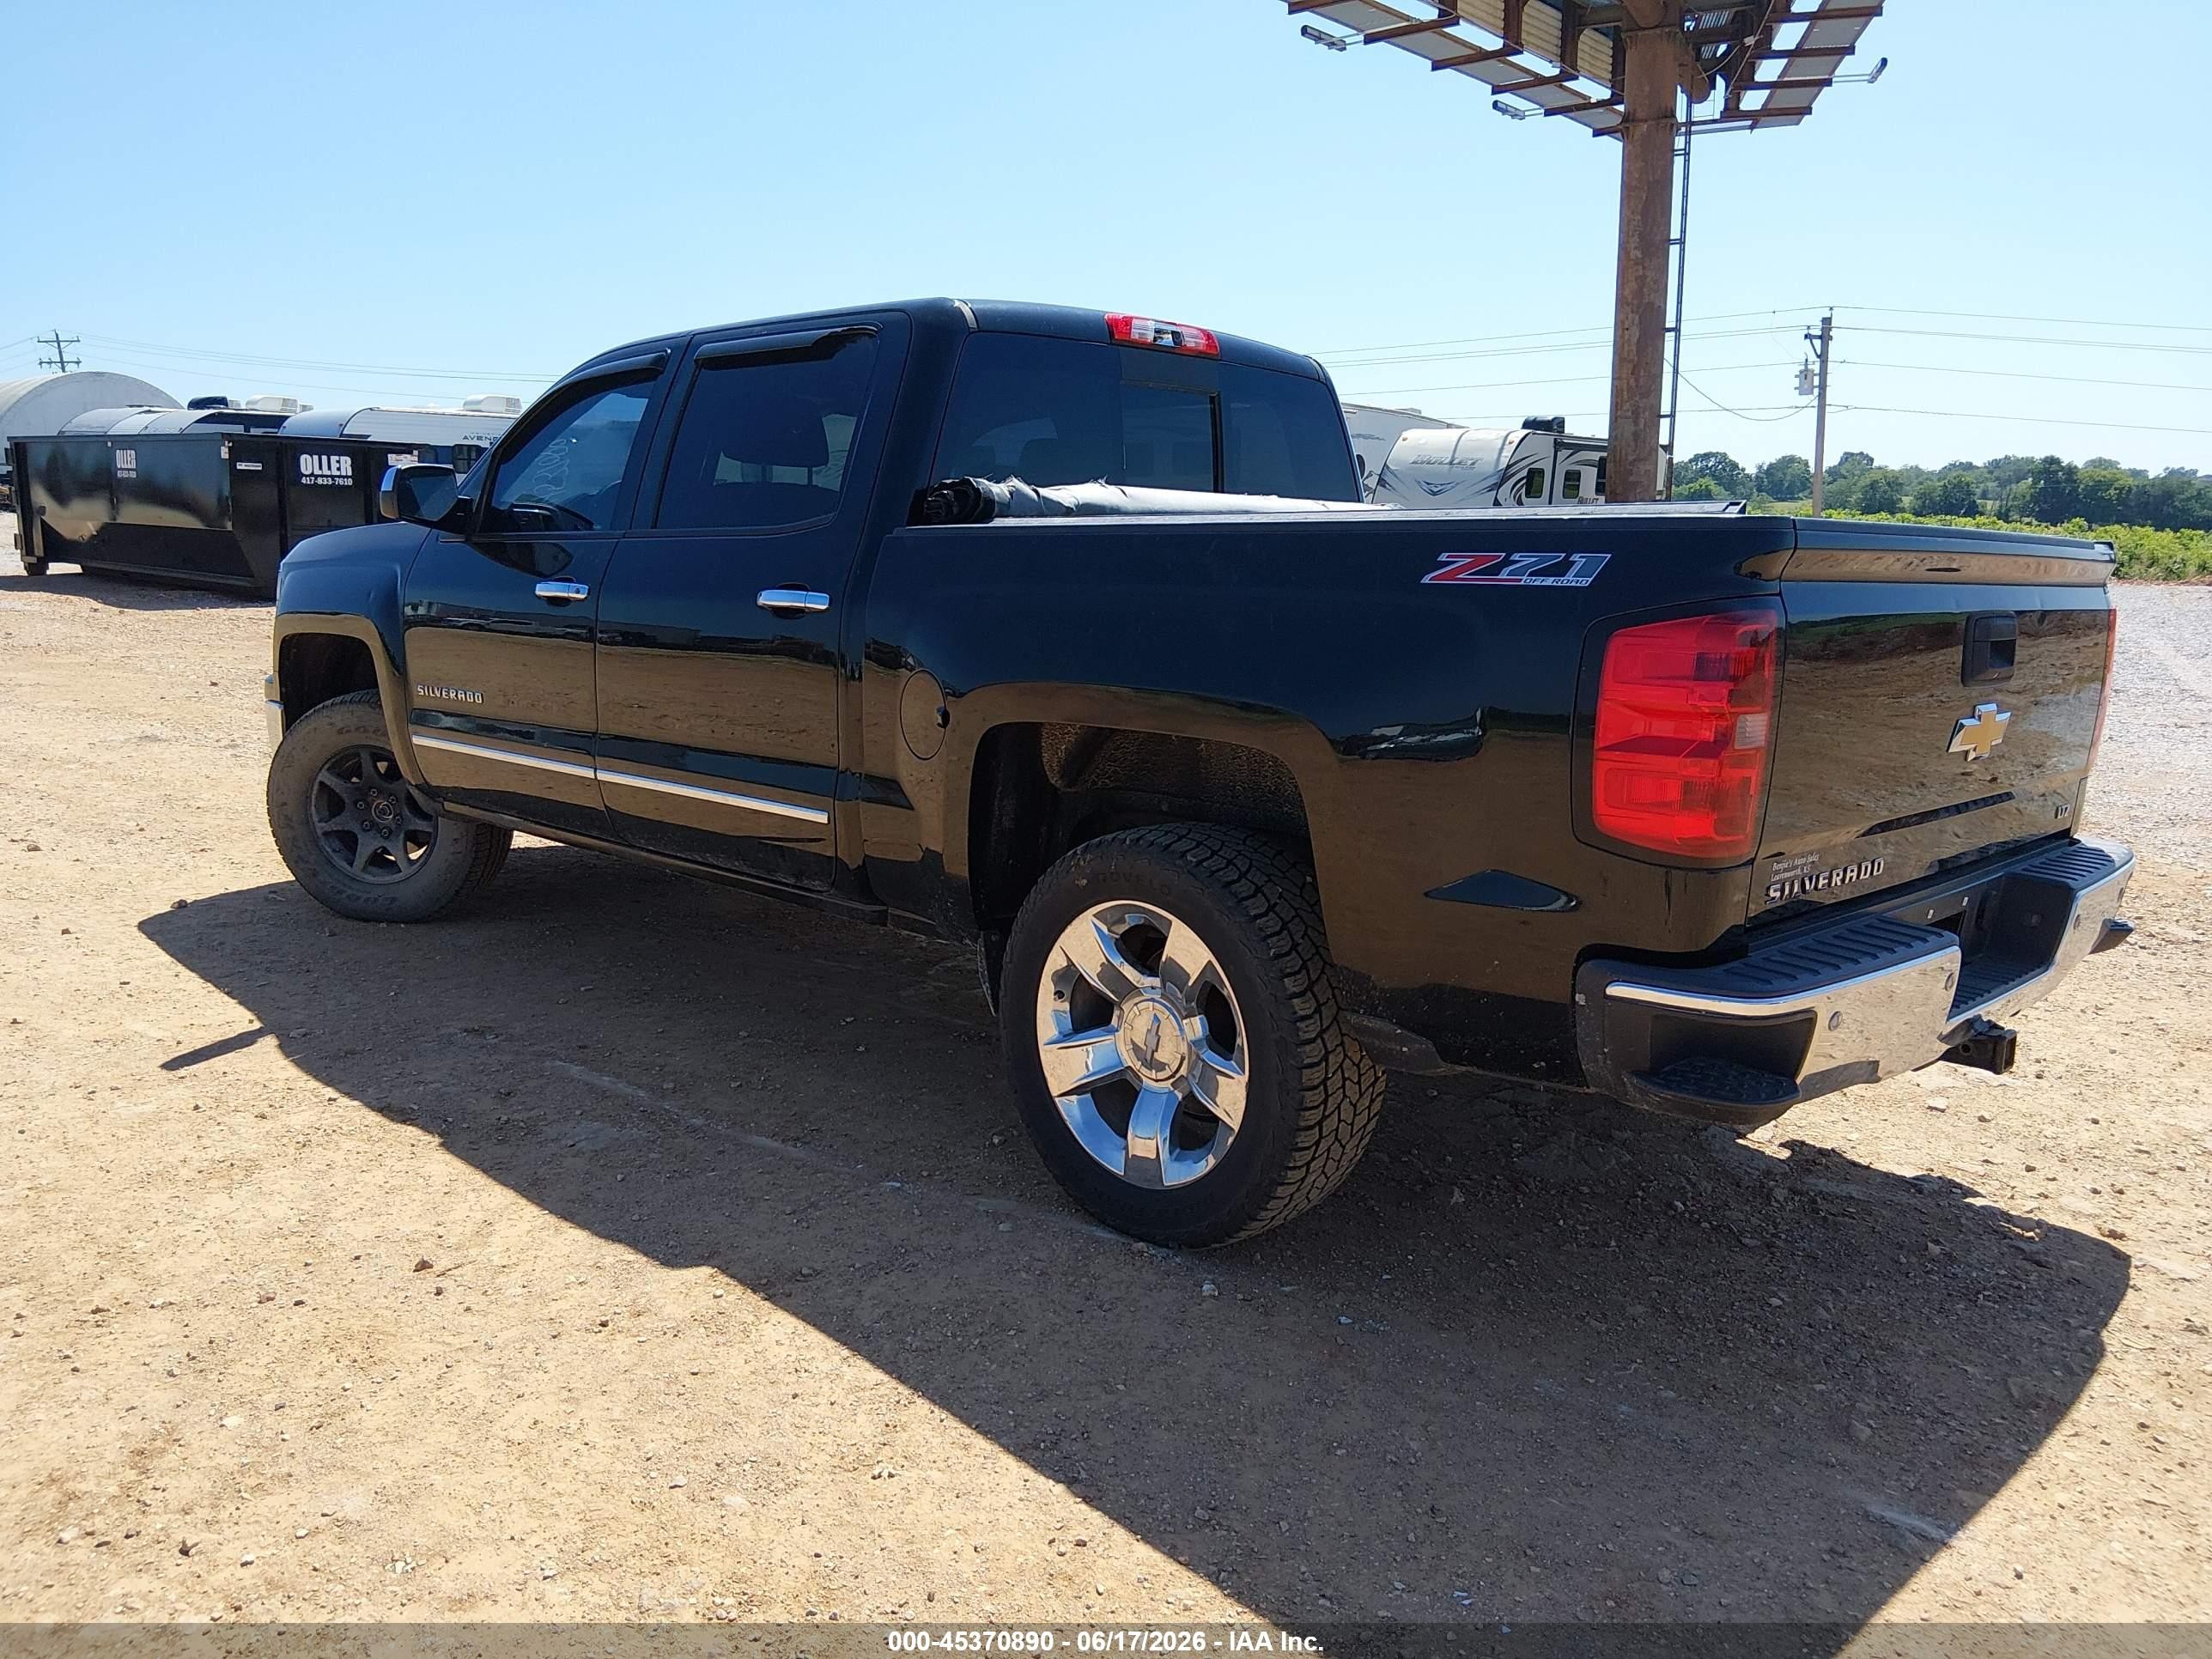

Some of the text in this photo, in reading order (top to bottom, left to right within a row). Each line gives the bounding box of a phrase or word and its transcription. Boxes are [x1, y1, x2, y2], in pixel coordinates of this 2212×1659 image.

[116, 449, 137, 469] OLLER
[300, 453, 353, 476] OLLER
[301, 476, 353, 486] 417-833-7610
[1420, 552, 1612, 585] Z71
[416, 684, 483, 704] SILVERADO
[1765, 857, 1885, 904] SILVERADO
